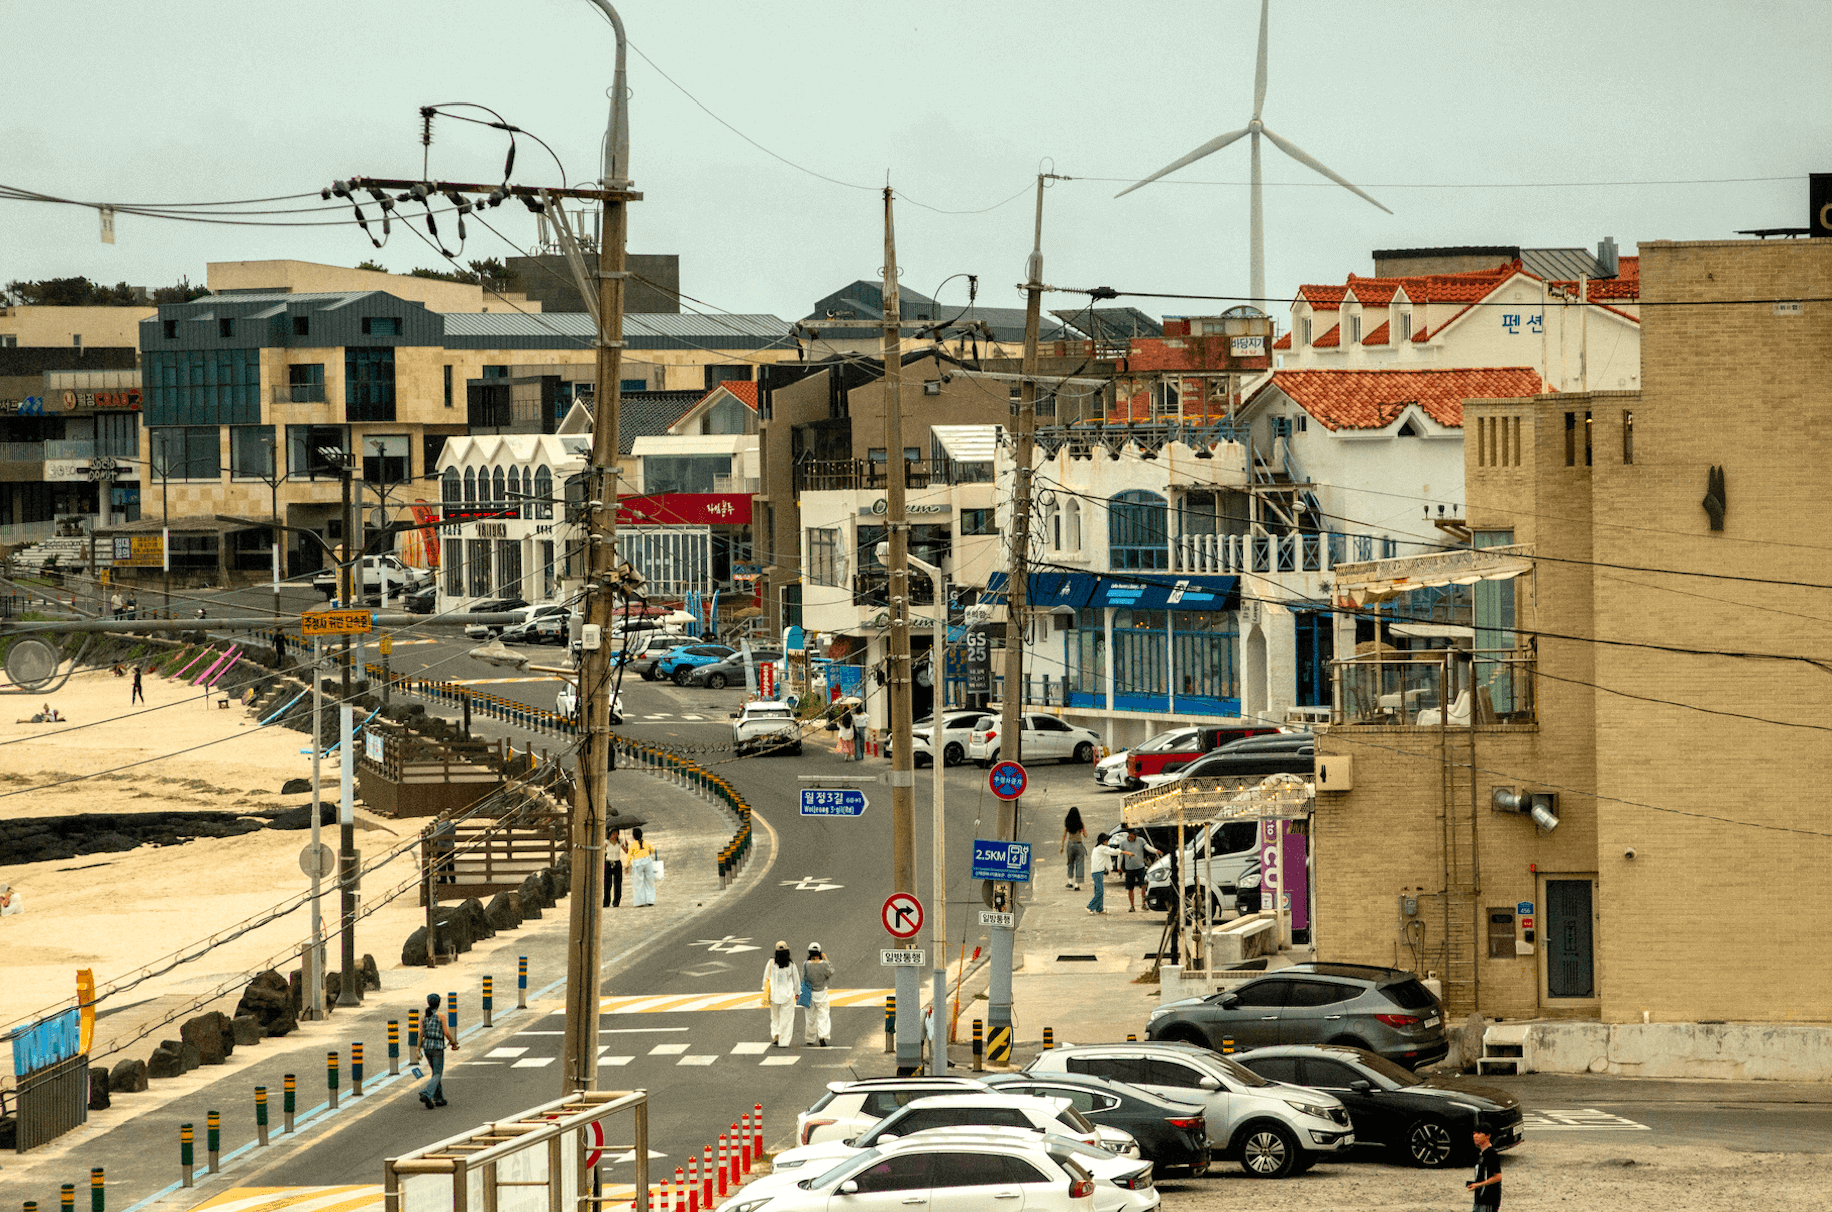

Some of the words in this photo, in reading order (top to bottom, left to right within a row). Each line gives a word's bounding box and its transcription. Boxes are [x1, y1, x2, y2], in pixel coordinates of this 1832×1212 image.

[88, 470, 118, 483] DONUT
[966, 632, 987, 647] GS
[967, 647, 987, 662] 25
[804, 791, 844, 805] 월정3길
[975, 849, 1006, 862] 2.5KM
[982, 912, 1011, 925] 일방통행
[885, 952, 921, 963] 일방통행
